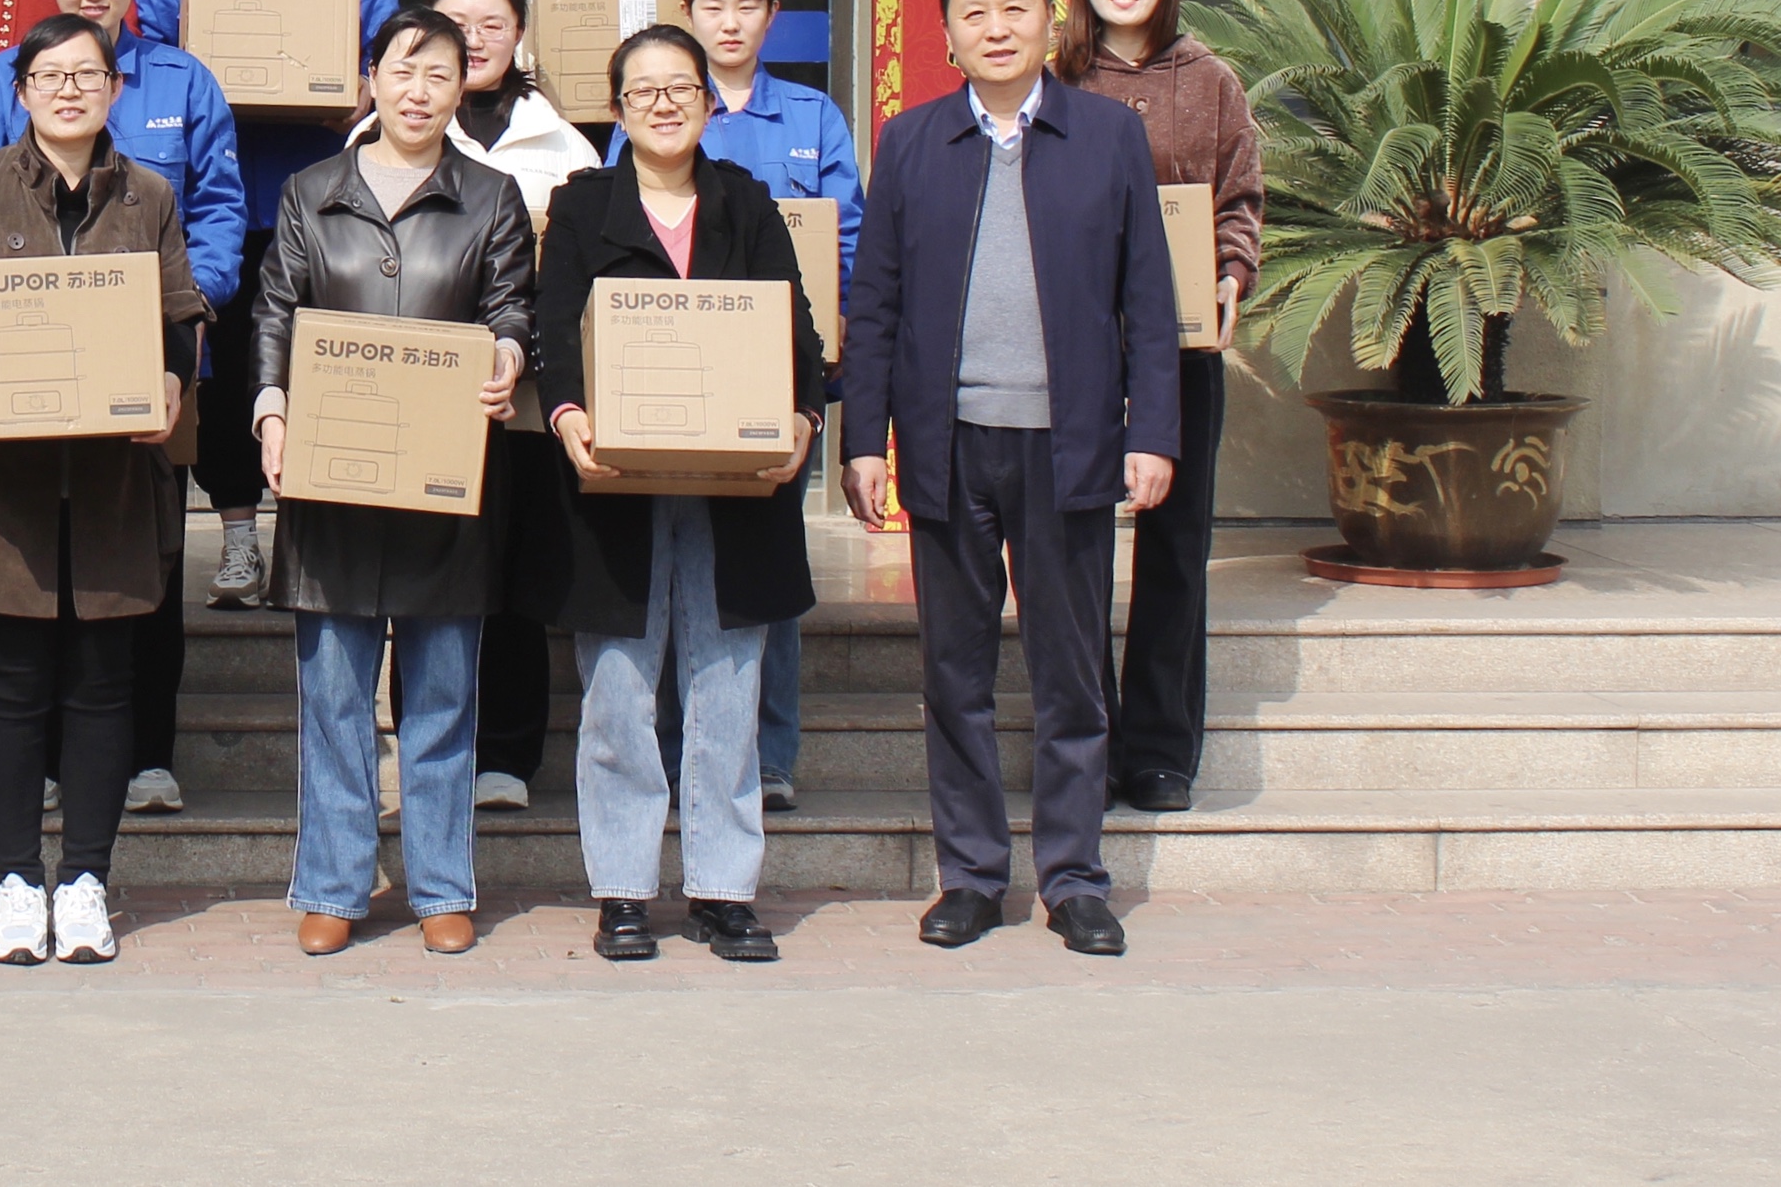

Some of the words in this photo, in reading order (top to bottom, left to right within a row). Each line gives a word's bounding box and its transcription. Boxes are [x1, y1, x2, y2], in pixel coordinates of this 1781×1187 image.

[67, 269, 126, 289] 苏泊尔
[610, 293, 689, 311] SUPOR
[696, 294, 754, 311] 苏泊尔
[314, 339, 395, 362] SUPOR
[401, 347, 460, 368] 苏泊尔
